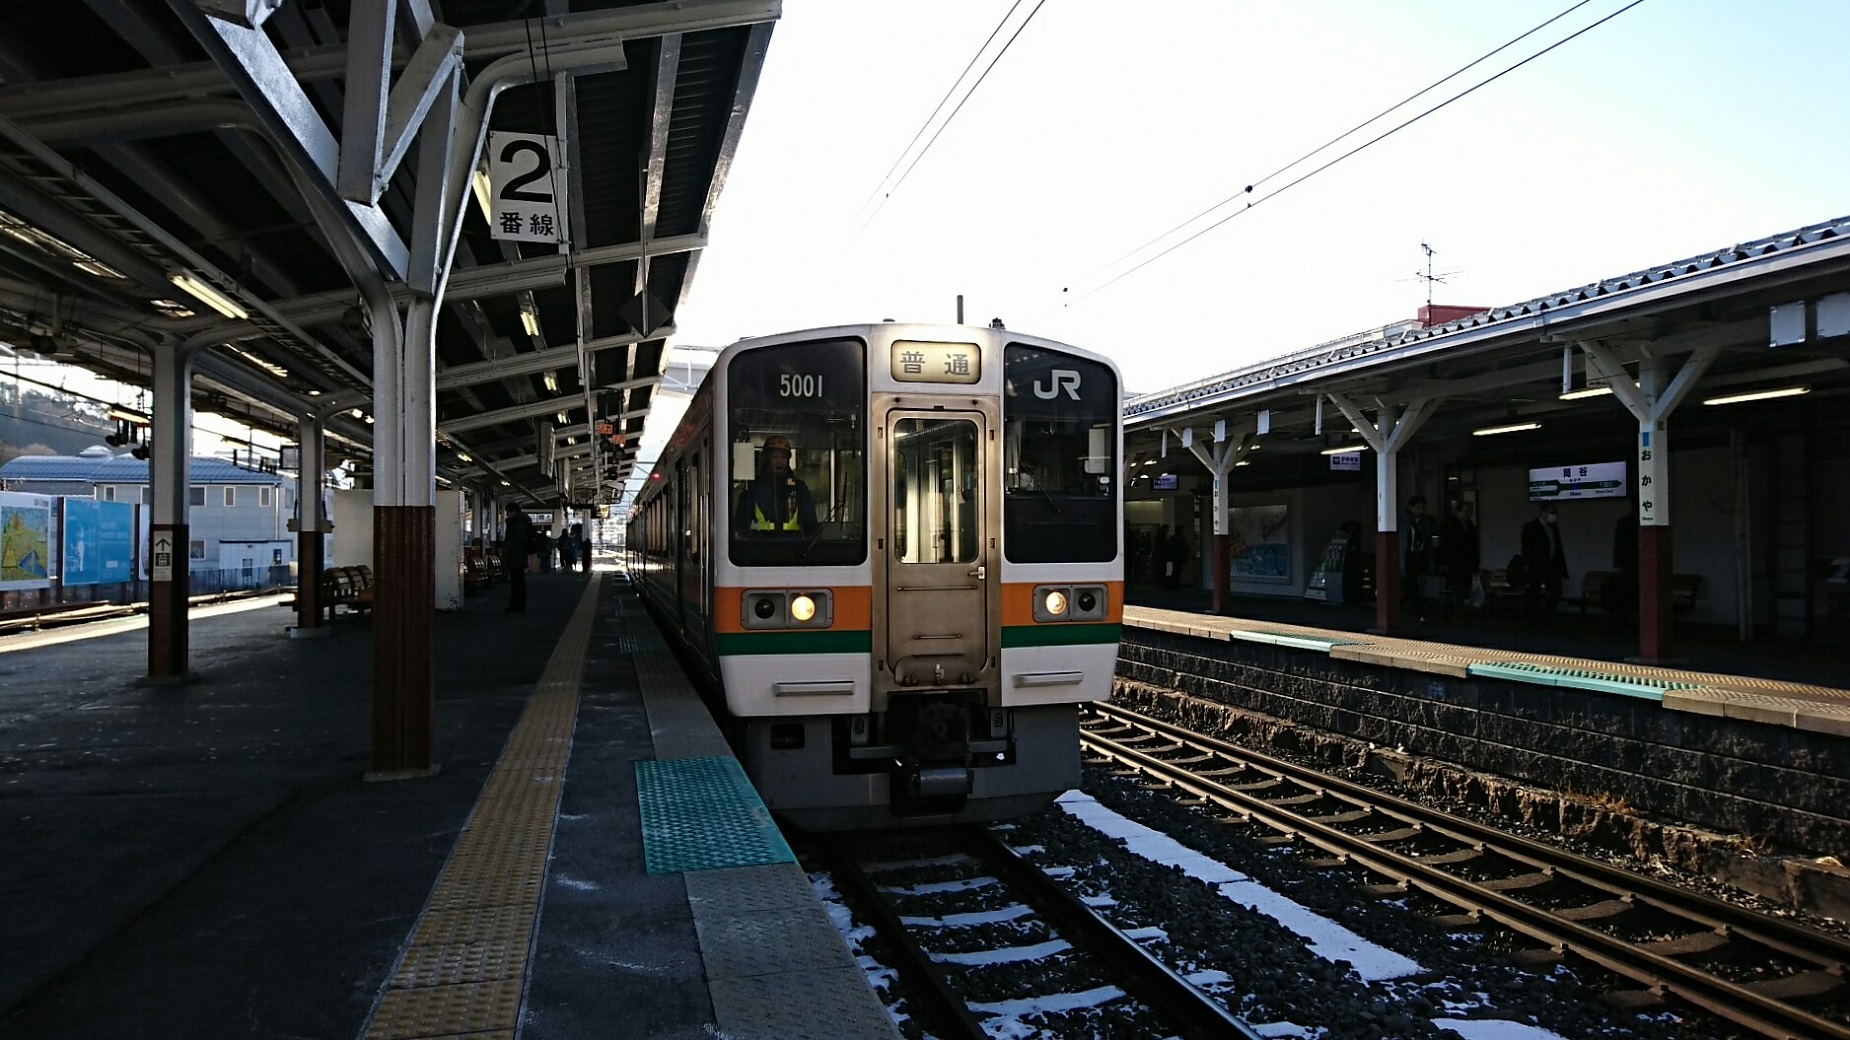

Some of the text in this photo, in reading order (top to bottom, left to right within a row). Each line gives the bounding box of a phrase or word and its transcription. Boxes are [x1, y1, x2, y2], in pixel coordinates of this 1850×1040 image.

[500, 140, 552, 203] 2
[500, 212, 553, 236] 番線
[900, 351, 970, 375] 普通
[780, 374, 823, 397] 5001
[1033, 369, 1082, 400] JR
[1563, 466, 1588, 478] 岡谷
[1641, 450, 1653, 512] おかや
